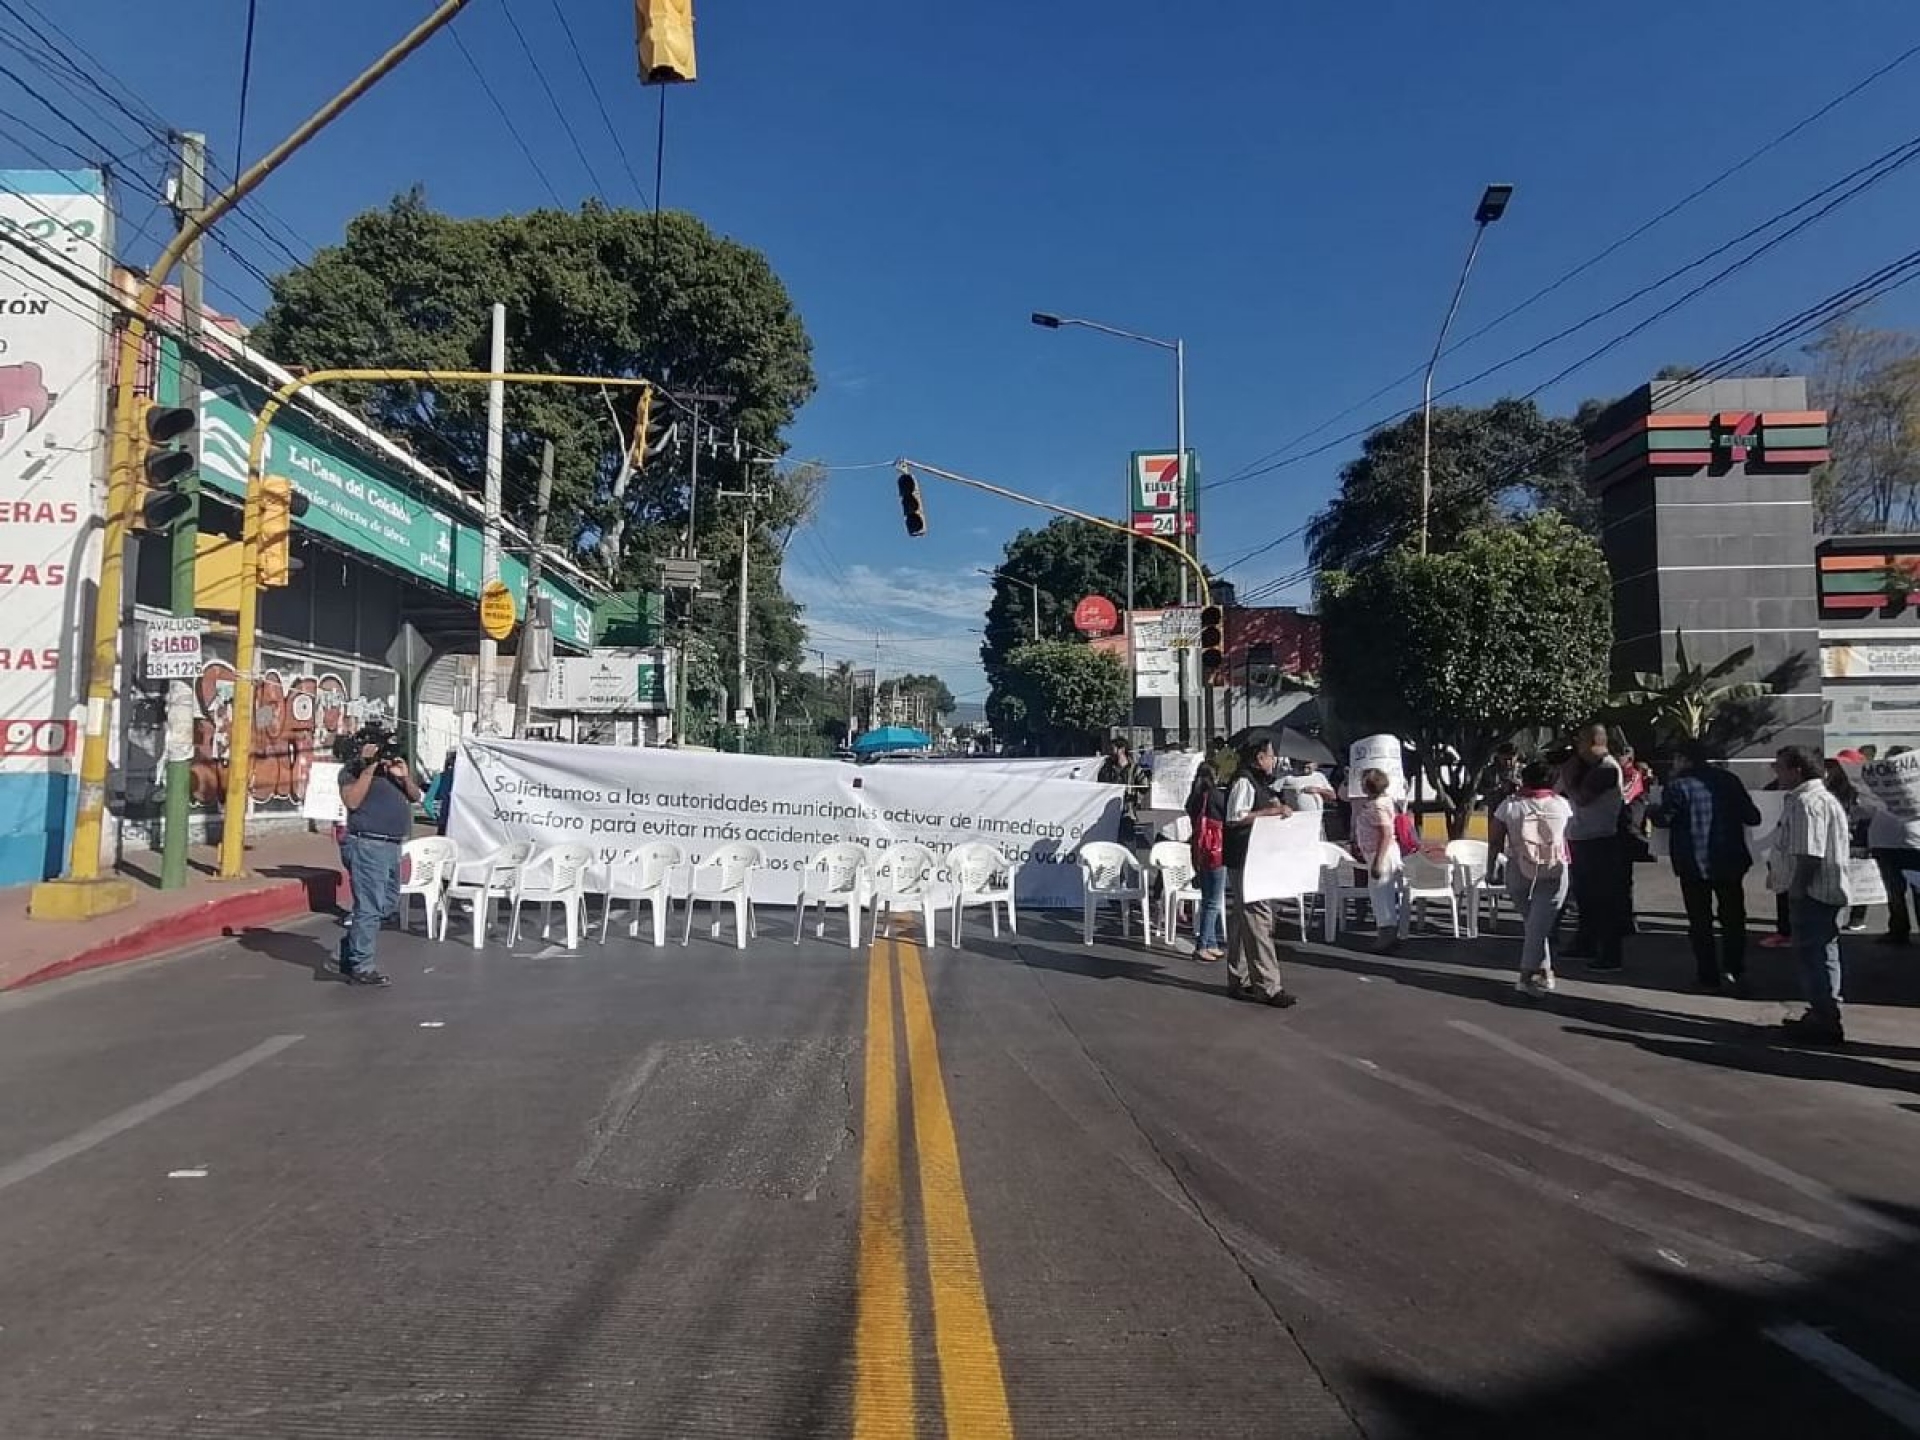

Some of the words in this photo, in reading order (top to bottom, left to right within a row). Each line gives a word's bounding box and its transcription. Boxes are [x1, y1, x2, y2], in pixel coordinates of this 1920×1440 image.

[0, 502, 77, 524] ERAS
[1154, 517, 1174, 532] 24
[0, 564, 64, 585] ZAS
[494, 775, 601, 802] Solicitamos
[607, 791, 621, 804] a
[626, 787, 651, 805] las
[656, 793, 768, 813] autoridades
[772, 800, 877, 820] municipales
[883, 809, 945, 826] activar
[950, 813, 972, 828] de
[978, 815, 1065, 838] inmediato
[643, 819, 698, 838] evitar
[703, 822, 741, 840] más
